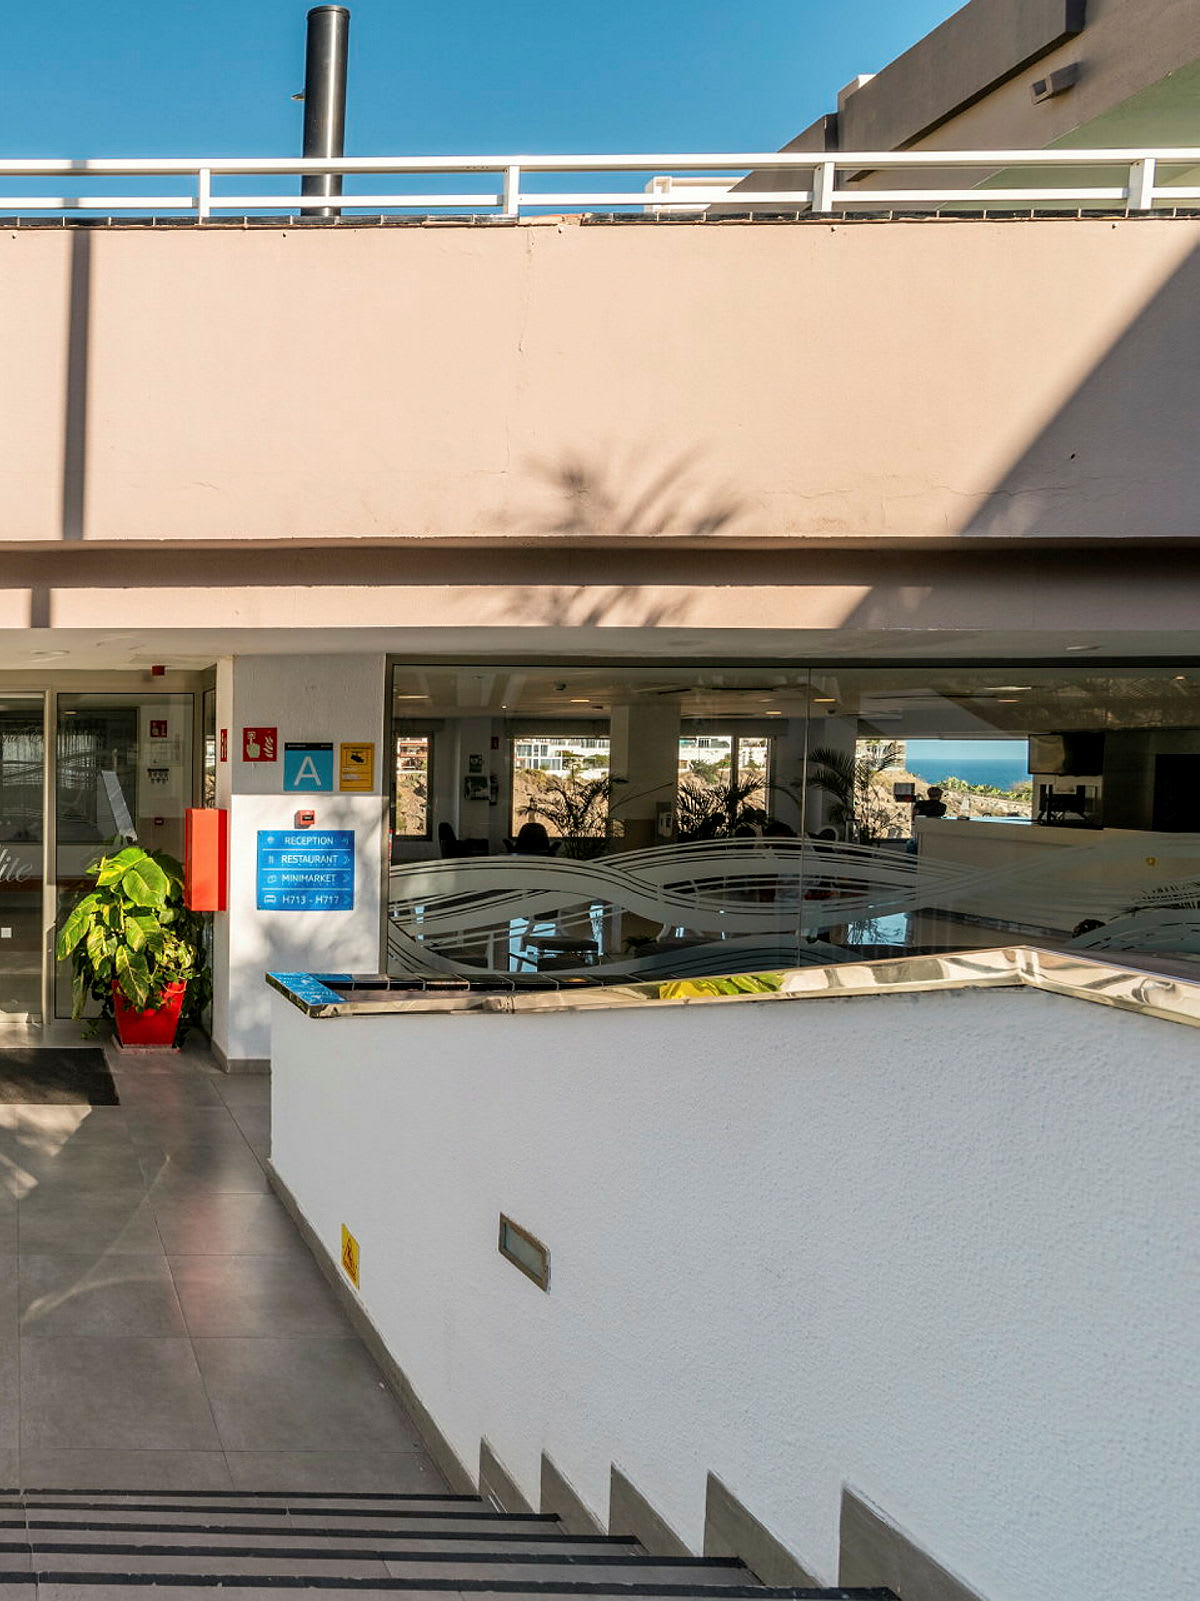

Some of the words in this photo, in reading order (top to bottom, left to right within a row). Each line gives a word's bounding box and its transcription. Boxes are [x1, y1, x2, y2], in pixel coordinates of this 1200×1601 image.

[293, 756, 322, 786] A
[284, 836, 334, 846] RECEPTION
[281, 854, 339, 864] RESTAURANT
[281, 873, 337, 883] MINIMARKET
[282, 894, 306, 904] H713
[315, 894, 339, 904] H717
